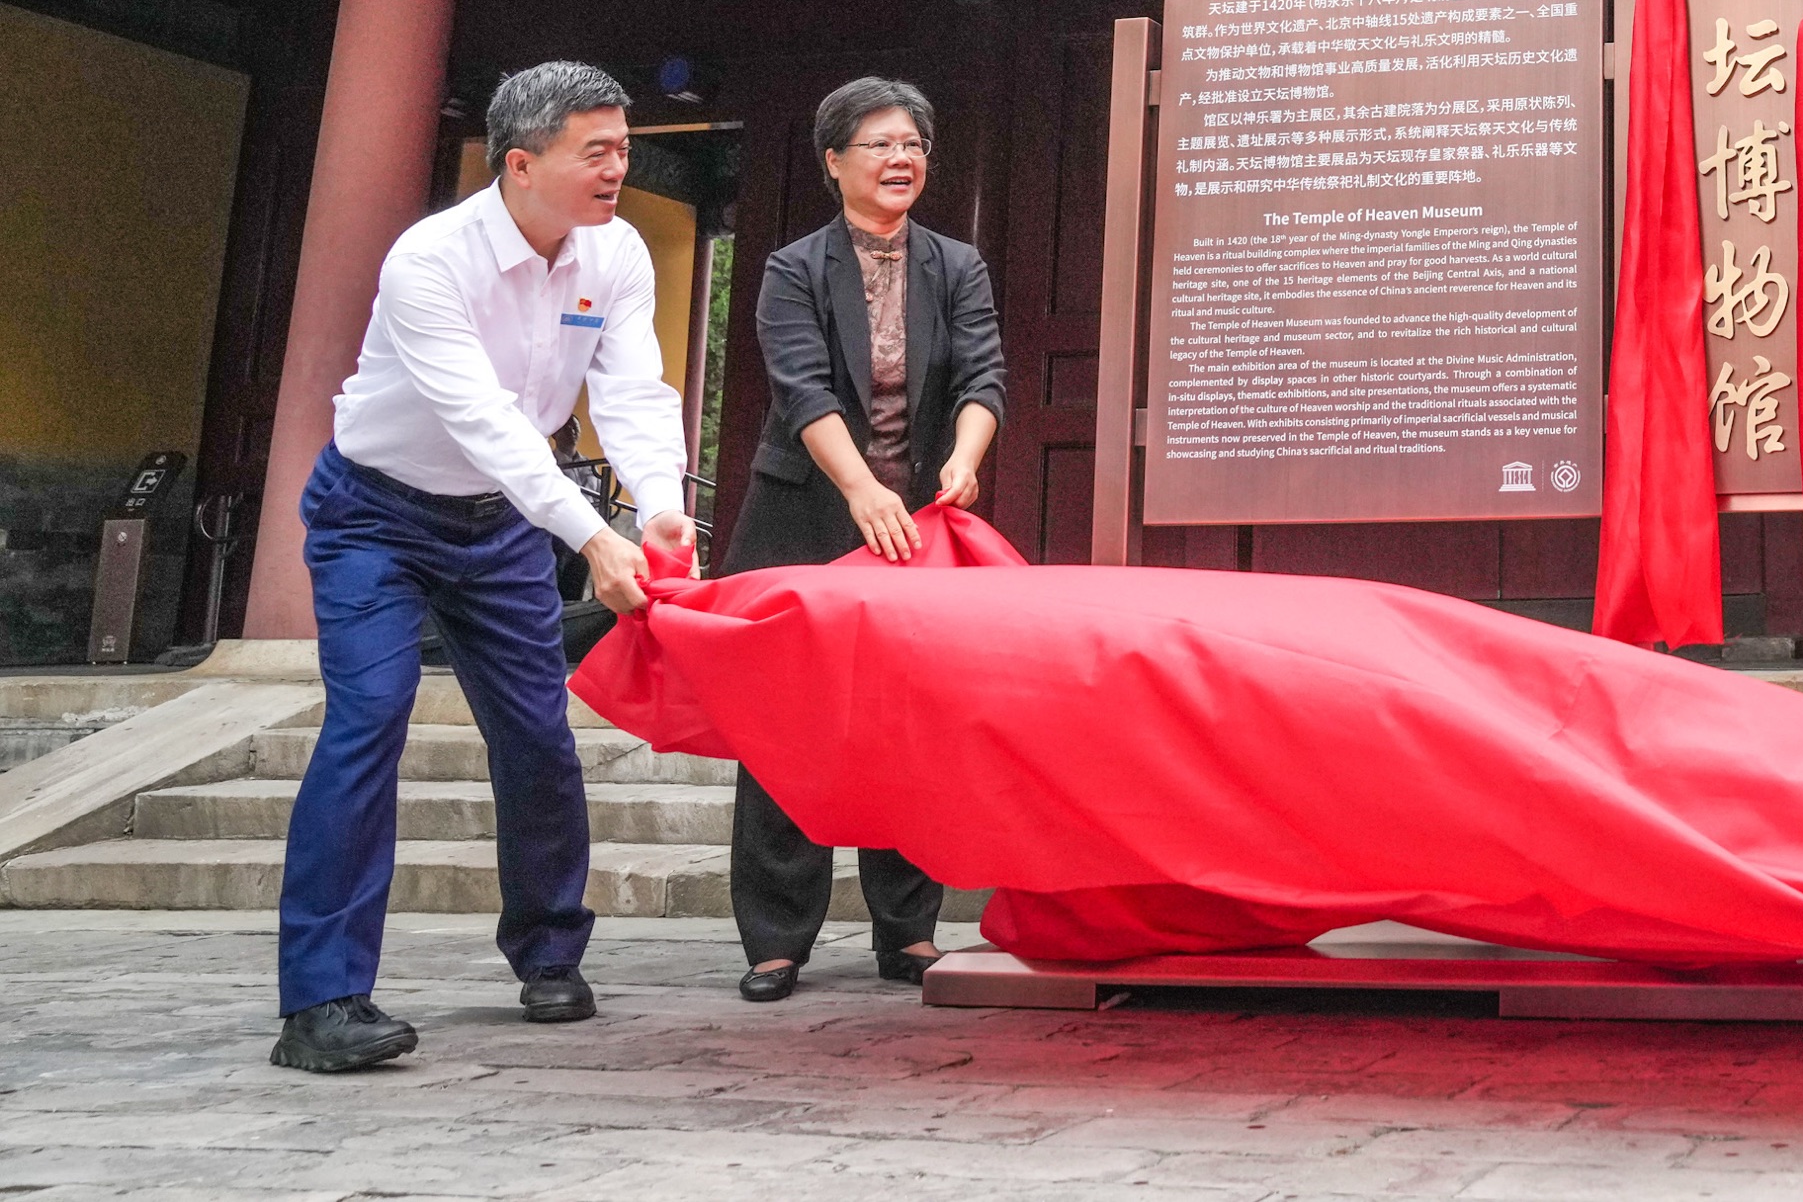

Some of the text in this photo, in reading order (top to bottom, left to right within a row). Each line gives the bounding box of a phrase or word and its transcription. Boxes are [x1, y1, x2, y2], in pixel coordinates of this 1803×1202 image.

[1178, 84, 1334, 106] 产，经批准设立天坛博物馆。
[1263, 205, 1482, 226] The Temple of Heaven Museum
[1193, 237, 1213, 246] Built
[1216, 237, 1224, 245] in
[1227, 236, 1247, 245] 1420
[1250, 235, 1267, 245] (the
[1288, 235, 1308, 244] year
[1310, 232, 1320, 241] of
[1321, 232, 1336, 241] the
[1339, 230, 1398, 242] Ming-dynasty
[1400, 227, 1430, 239] Yongle
[1513, 223, 1528, 232] the
[1530, 221, 1565, 233] Temple
[1567, 220, 1577, 230] of
[1173, 265, 1192, 275] held
[1193, 264, 1243, 274] ceremonies
[1244, 264, 1254, 272] to
[1256, 262, 1277, 272] offer
[1278, 261, 1319, 271] sacrifices
[1321, 261, 1331, 269] to
[1332, 260, 1365, 268] Heaven
[1367, 257, 1385, 267] and
[1387, 259, 1407, 268] pray
[1409, 256, 1422, 265] for
[1423, 255, 1446, 267] good
[1491, 253, 1503, 262] As
[1512, 251, 1539, 261] world
[1541, 249, 1577, 260] cultural
[1189, 321, 1206, 330] The
[1207, 320, 1239, 331] Temple
[1240, 319, 1250, 328] of
[1251, 319, 1284, 328] Heaven
[1285, 318, 1322, 327] Museum
[1343, 314, 1380, 324] founded
[1381, 315, 1391, 323] to
[1393, 313, 1430, 323] advance
[1431, 312, 1447, 322] the
[1448, 310, 1503, 323] high-quality
[1504, 308, 1566, 320] development
[1567, 306, 1577, 317] of
[1188, 363, 1205, 372] The
[1207, 362, 1229, 372] main
[1231, 361, 1275, 371] exhibition
[1278, 362, 1297, 370] area
[1299, 359, 1310, 369] of
[1311, 359, 1326, 369] the
[1329, 360, 1367, 368] museum
[1370, 357, 1378, 367] is
[1380, 356, 1413, 366] located
[1416, 357, 1425, 365] at
[1427, 355, 1443, 365] the
[1446, 354, 1474, 364] Divine
[1477, 353, 1503, 363] Music
[1168, 392, 1195, 401] in-situ
[1237, 389, 1276, 399] thematic
[1330, 387, 1347, 396] and
[1349, 387, 1366, 396] site
[1433, 384, 1449, 393] the
[1450, 385, 1490, 393] museum
[1491, 382, 1518, 392] offers
[1527, 380, 1577, 393] systematic
[1166, 435, 1219, 444] instruments
[1221, 435, 1240, 443] now
[1242, 432, 1286, 443] preserved
[1288, 432, 1297, 441] in
[1299, 431, 1314, 441] the
[1316, 430, 1349, 442] Temple
[1351, 430, 1361, 439] of
[1401, 429, 1417, 438] the
[1419, 429, 1458, 438] museum
[1460, 426, 1491, 437] stands
[1493, 428, 1504, 436] as
[1514, 426, 1531, 437] key
[1532, 427, 1561, 435] venue
[1563, 424, 1577, 434] for
